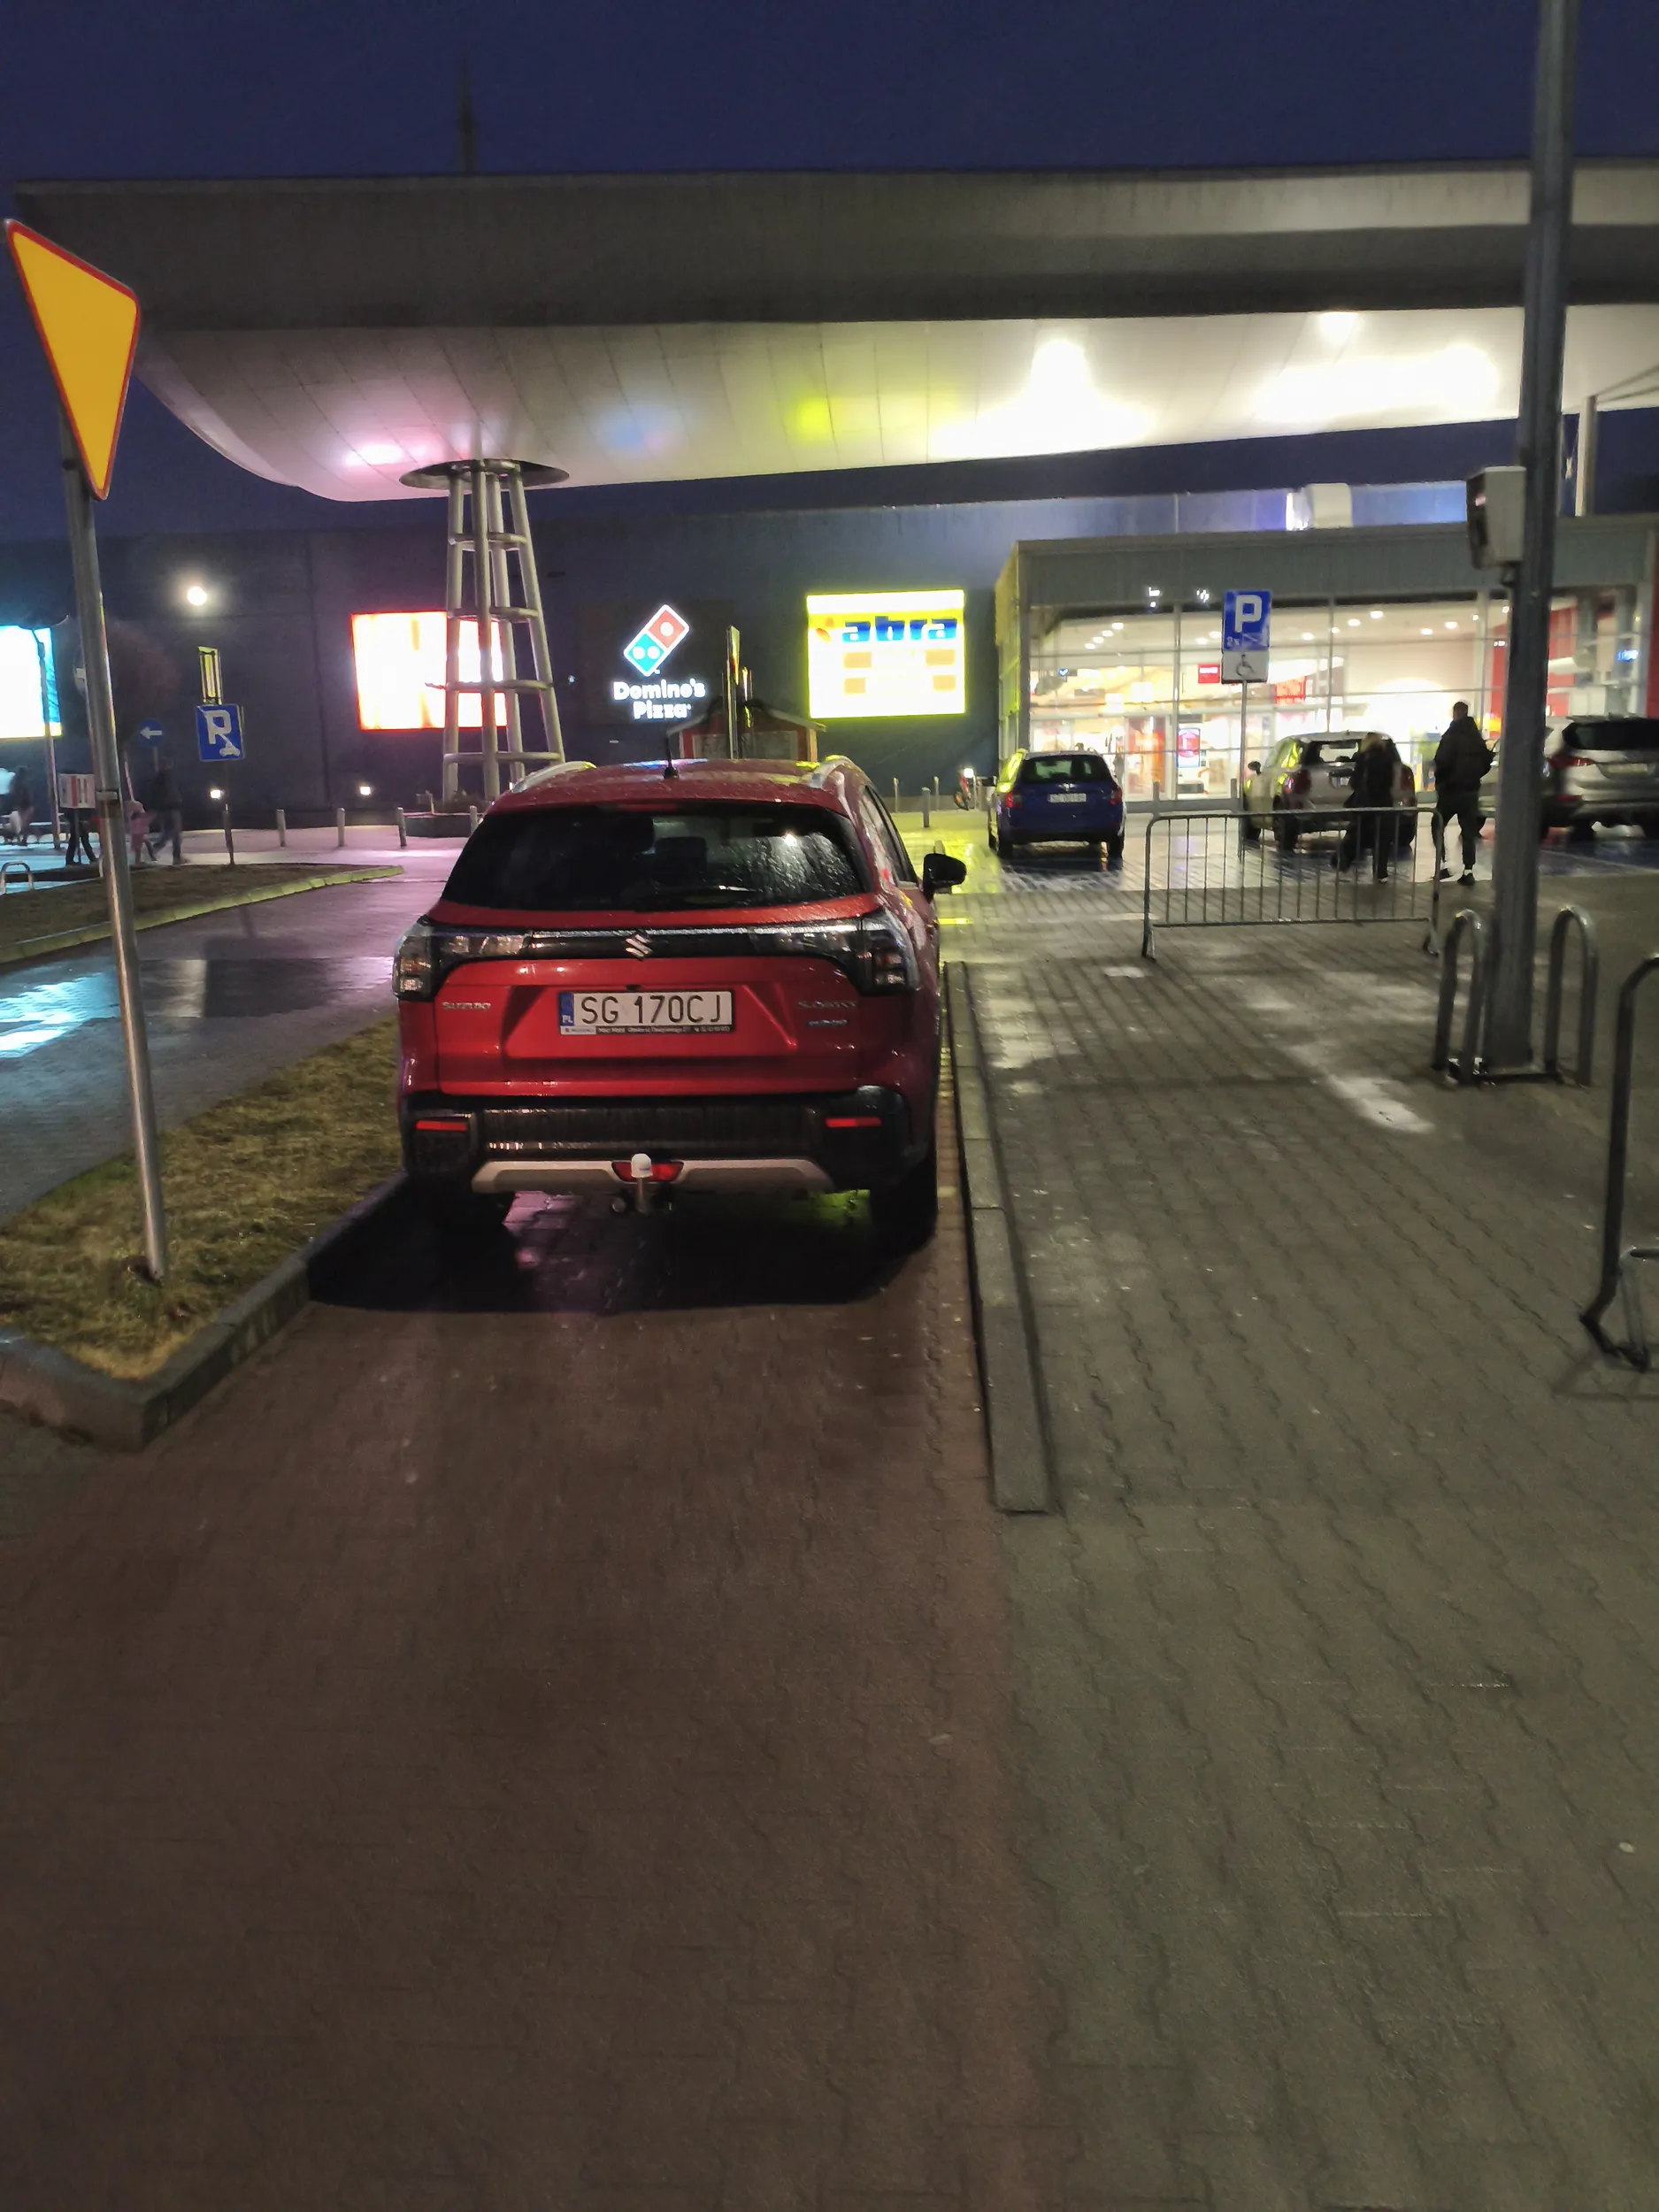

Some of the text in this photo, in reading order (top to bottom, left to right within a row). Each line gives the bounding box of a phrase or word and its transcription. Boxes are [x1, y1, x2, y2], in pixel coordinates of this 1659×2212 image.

[1235, 595, 1262, 633] P
[613, 678, 706, 700] Domino's
[633, 700, 687, 719] Pizza
[562, 1014, 573, 1024] PL
[580, 995, 721, 1024] SG 170CJ
